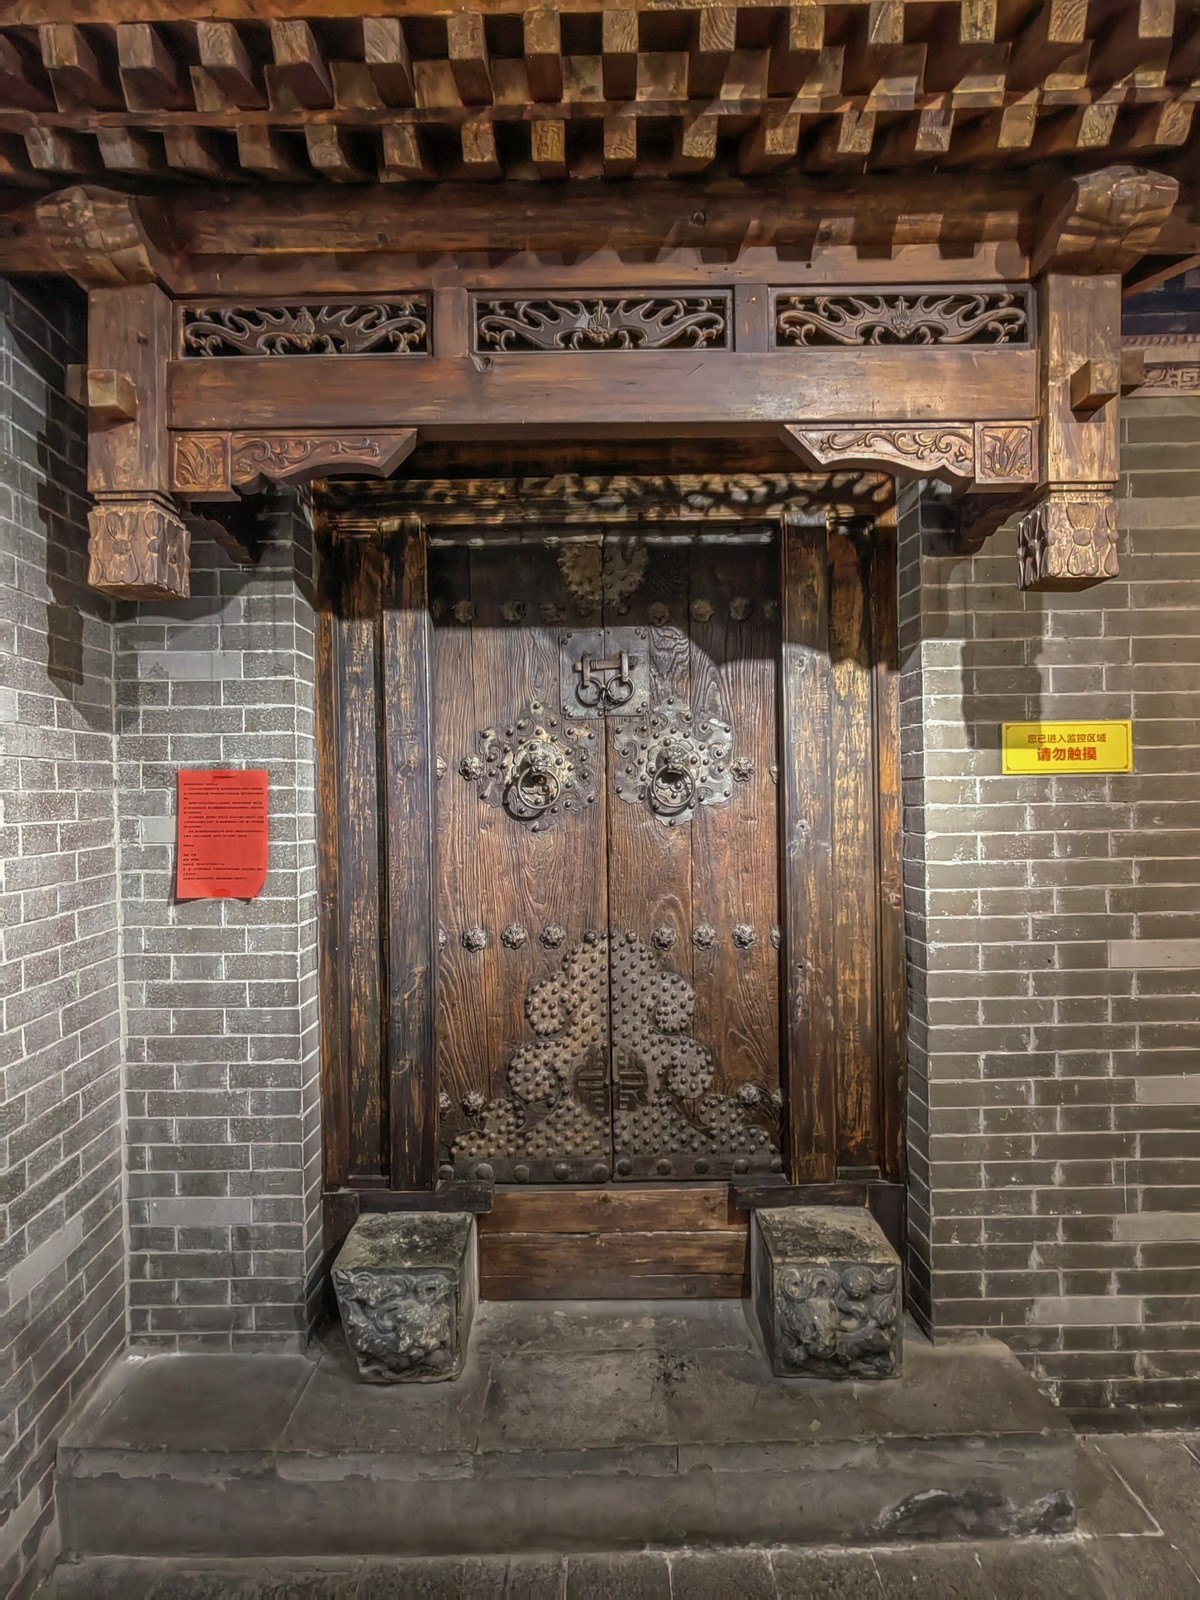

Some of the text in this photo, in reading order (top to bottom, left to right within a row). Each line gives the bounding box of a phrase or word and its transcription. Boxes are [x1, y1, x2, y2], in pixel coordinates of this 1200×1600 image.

[1027, 733, 1107, 744] 您已进入监控区域
[1037, 746, 1098, 761] 请勿触摸
